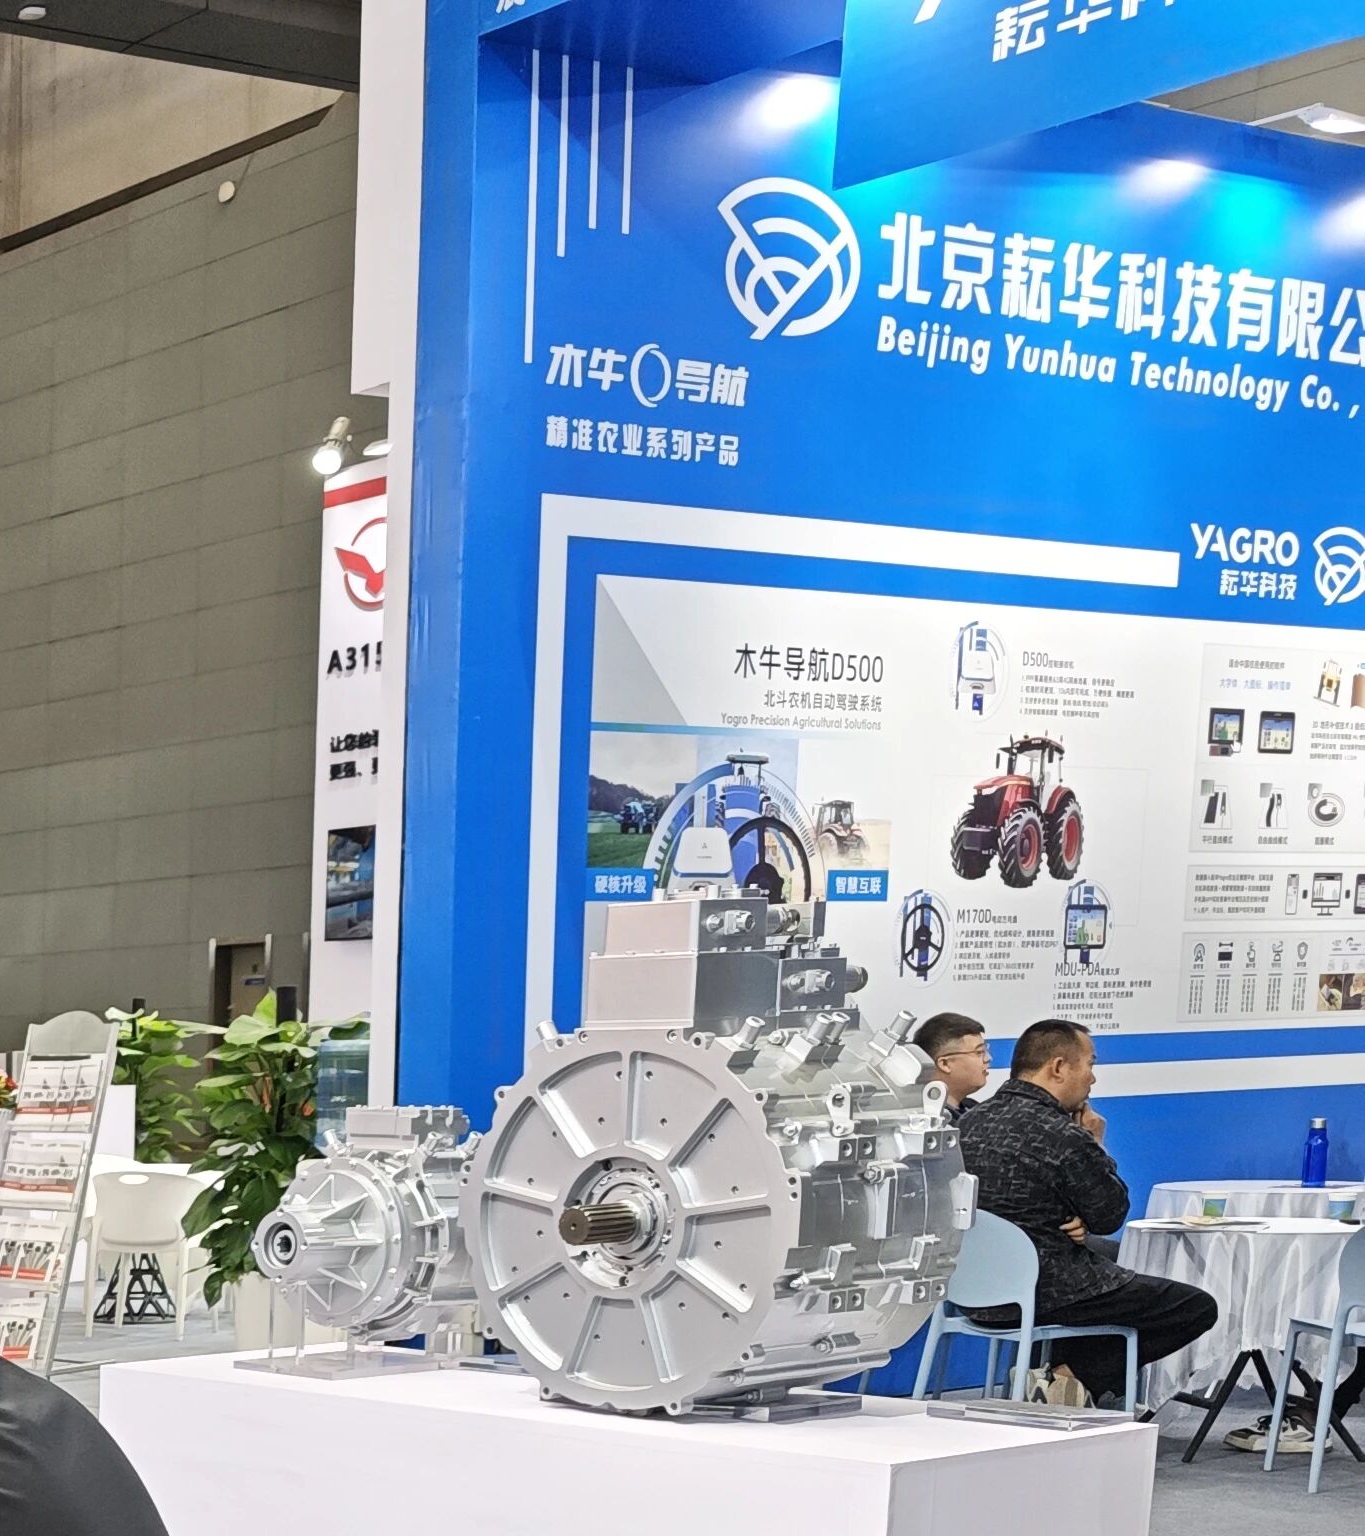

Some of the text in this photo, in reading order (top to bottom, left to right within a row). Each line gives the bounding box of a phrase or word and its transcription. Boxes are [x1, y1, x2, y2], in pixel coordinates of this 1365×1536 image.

[877, 315, 991, 374] Beijing
[1005, 334, 1116, 384] Yunhua
[1130, 352, 1290, 412] Technology
[545, 415, 739, 466] 精准农业系列产品
[1190, 522, 1300, 567] YAGRO
[1219, 569, 1297, 600] 耘华科技
[734, 643, 884, 683] 木牛导航D500
[763, 689, 883, 713] 北斗农机自动驾驶系统
[750, 713, 790, 727] Precision
[792, 715, 843, 730] Agricultural
[844, 717, 882, 731] Solutions
[835, 876, 882, 895] 智慧互联
